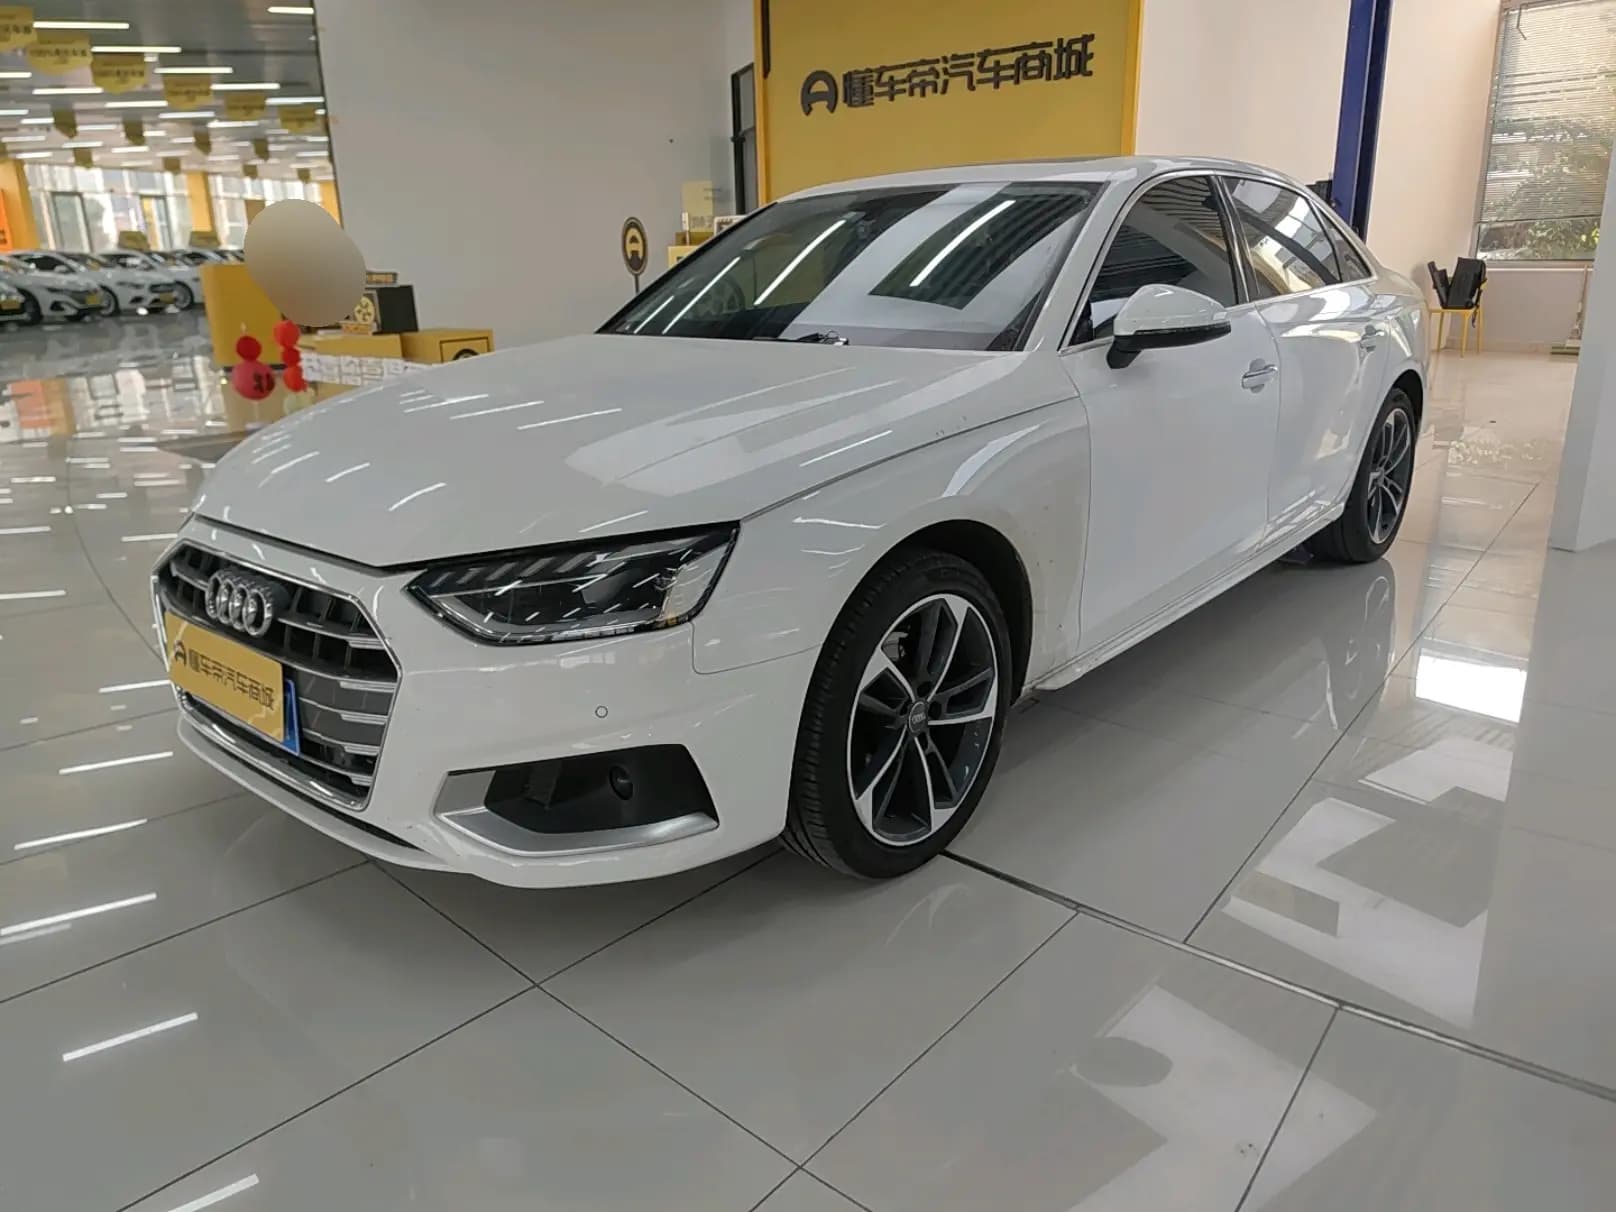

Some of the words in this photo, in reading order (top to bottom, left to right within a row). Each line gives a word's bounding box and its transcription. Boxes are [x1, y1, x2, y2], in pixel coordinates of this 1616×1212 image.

[842, 33, 1095, 108] 懂车帝汽车商城
